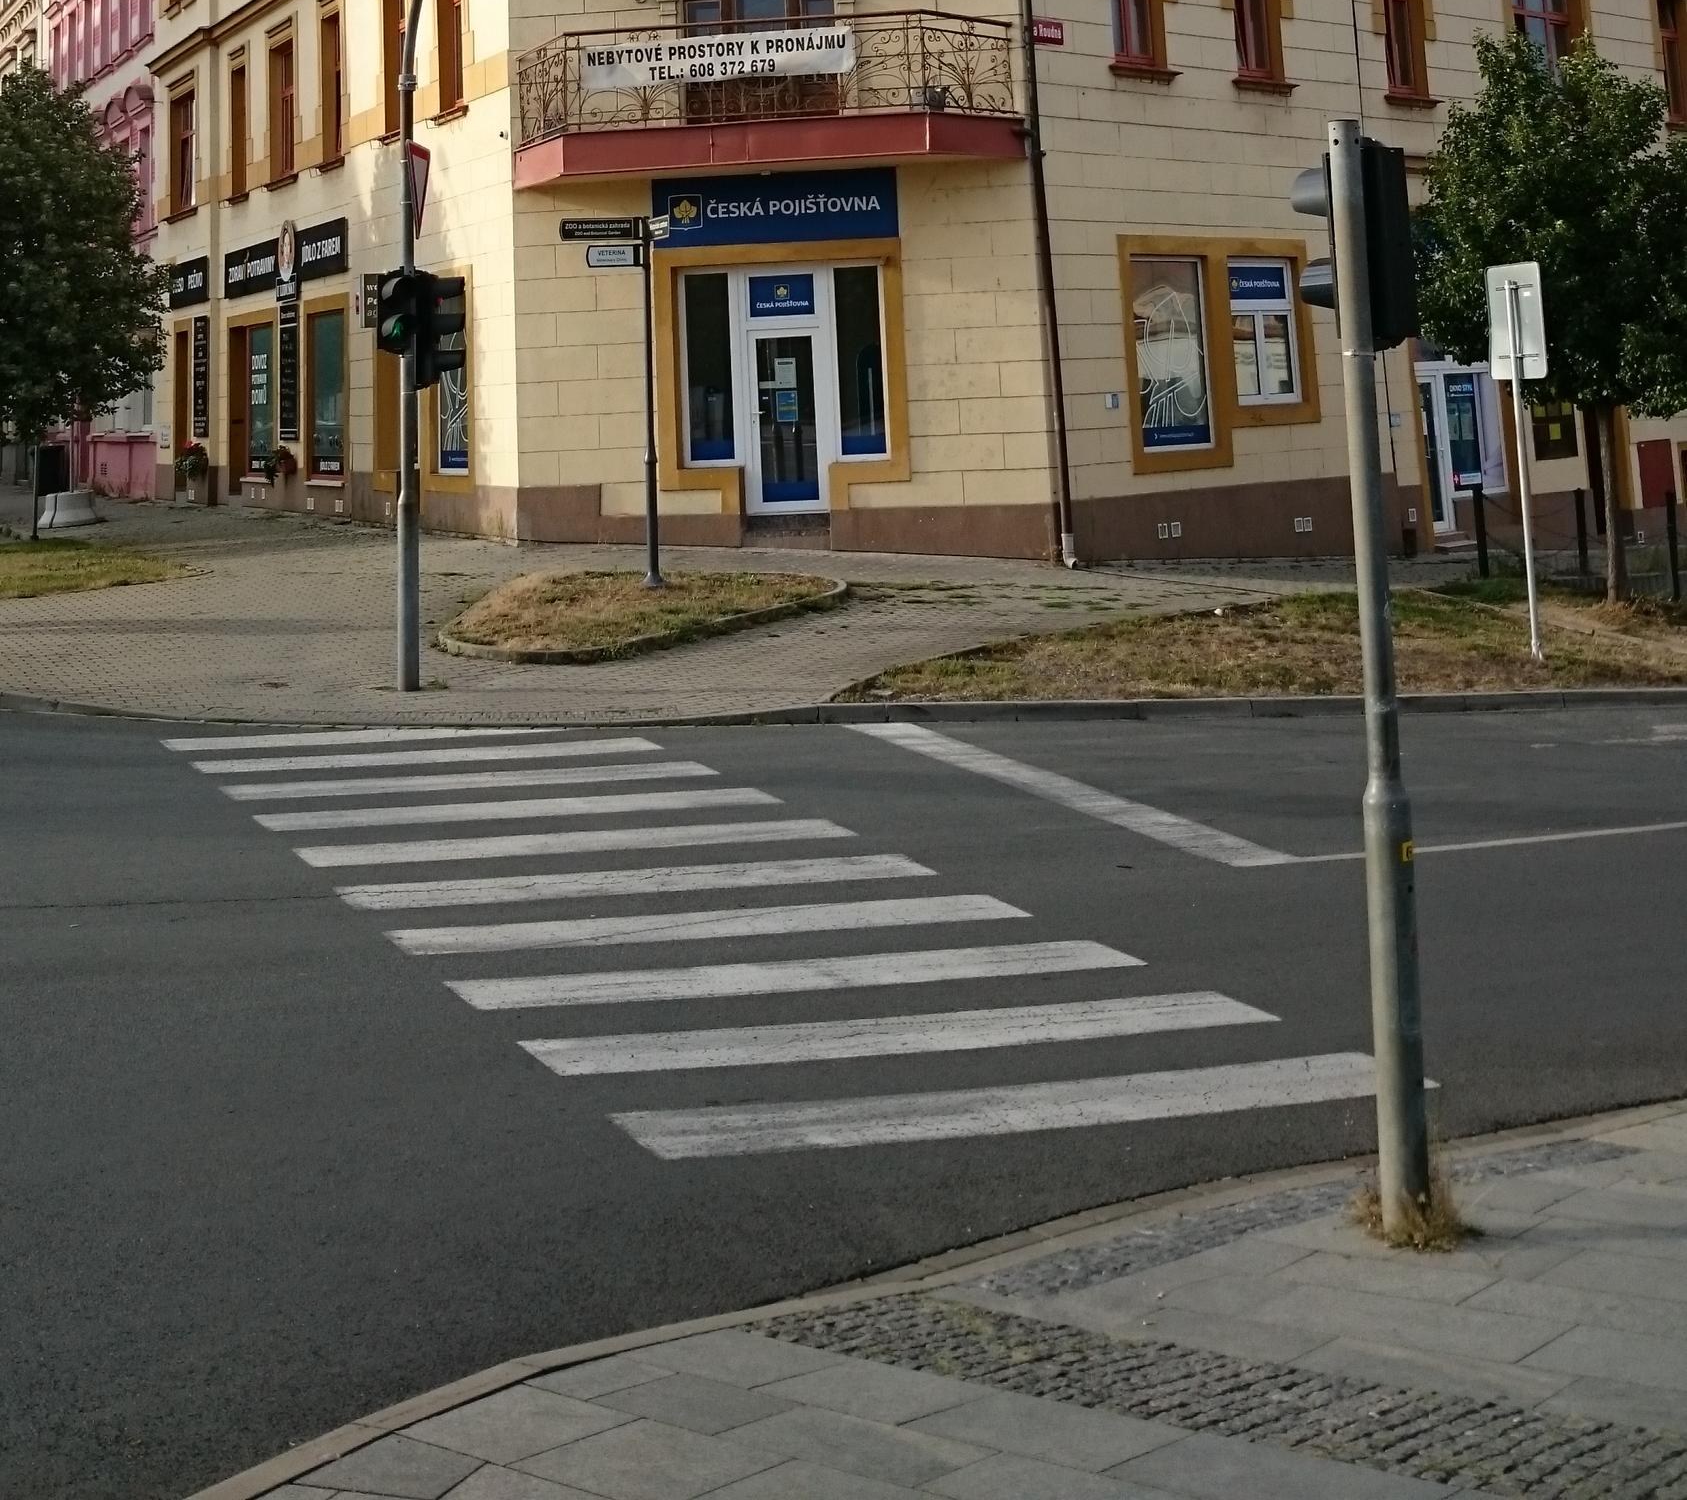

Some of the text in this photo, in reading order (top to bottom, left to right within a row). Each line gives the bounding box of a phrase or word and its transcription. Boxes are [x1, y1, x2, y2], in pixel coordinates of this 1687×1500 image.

[587, 32, 846, 67] NEBYTOVÉ PROSTORY K PRONÁJMU
[649, 58, 776, 81] TEL.: 608 372 679
[707, 193, 881, 219] ČESKÁ POJIŠŤOVNA
[756, 299, 809, 309] ČESKÁ POJIŠŤOVNA
[251, 354, 268, 370] DOVOZ
